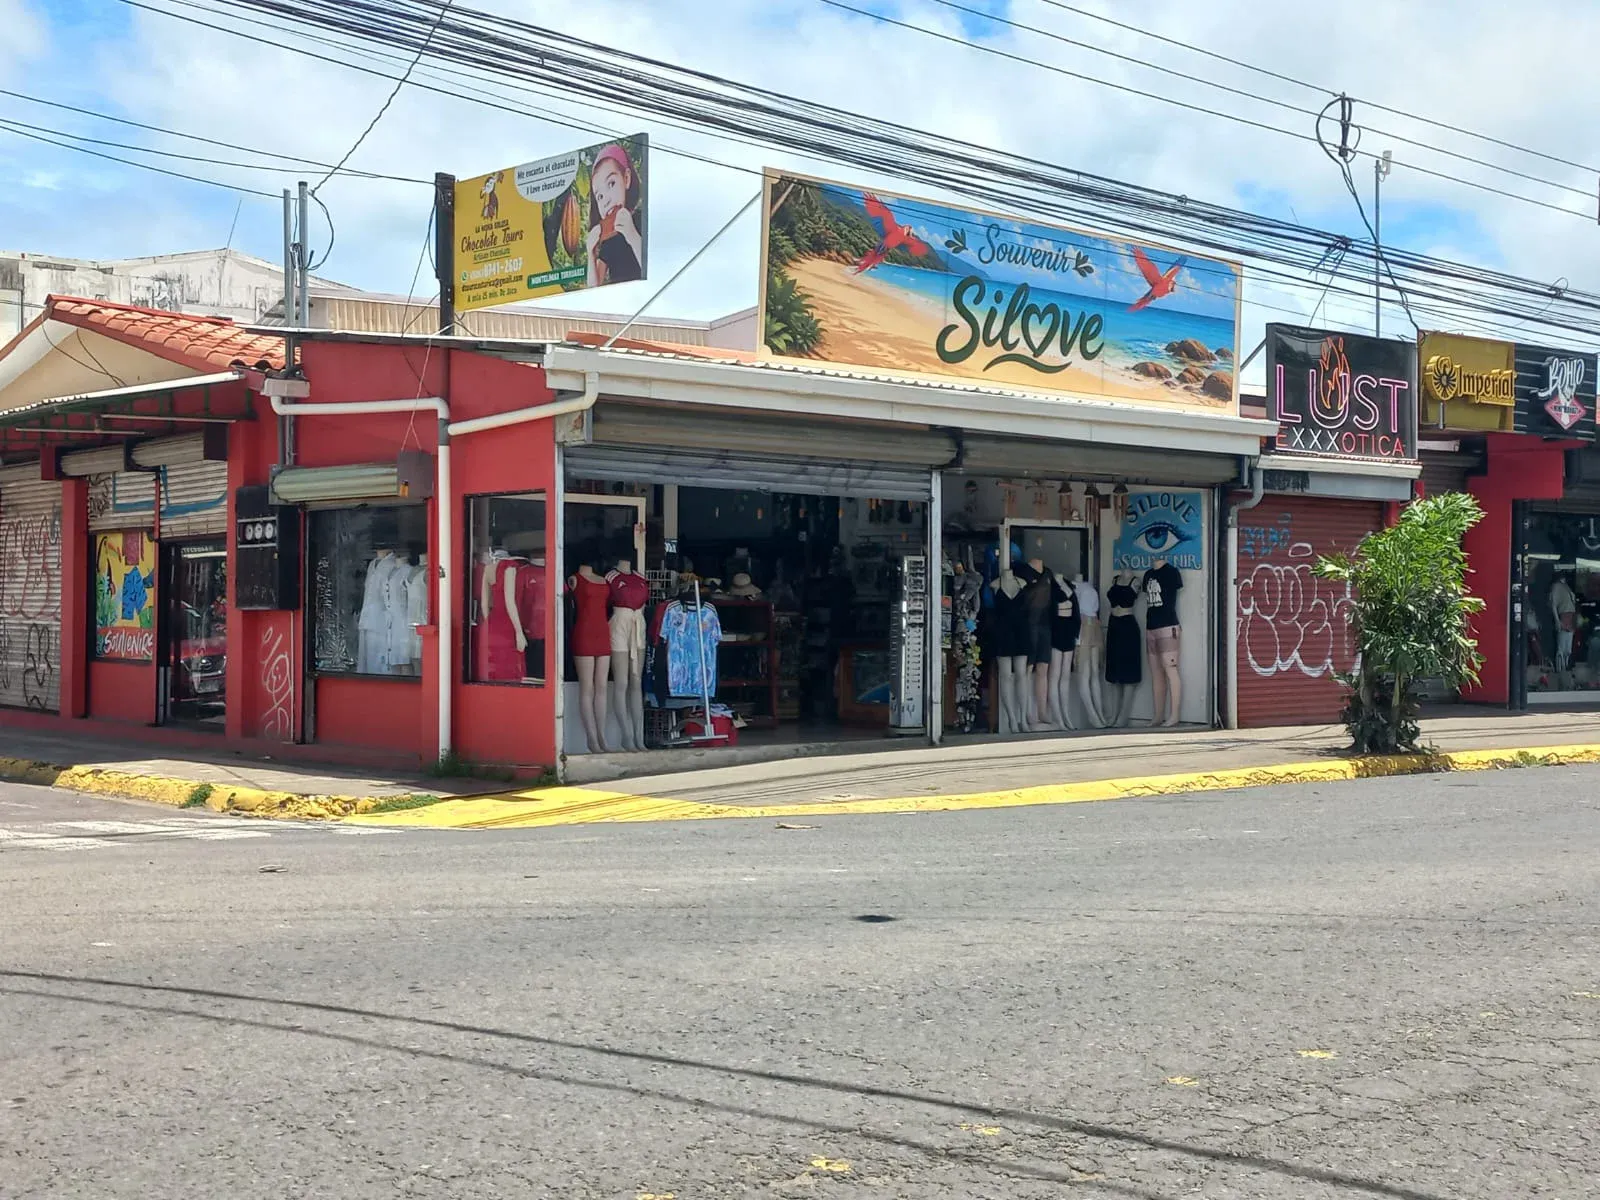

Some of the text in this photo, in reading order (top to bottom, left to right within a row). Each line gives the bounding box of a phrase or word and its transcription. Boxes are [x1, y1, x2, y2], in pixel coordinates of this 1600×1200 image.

[525, 166, 544, 178] encanta
[545, 163, 551, 173] el
[551, 158, 576, 171] chocolate
[541, 179, 566, 191] chocolate
[461, 227, 524, 253] Chocolate Tours
[978, 223, 1076, 273] Souvenir
[936, 275, 1105, 364] Silove
[1276, 364, 1409, 433] LUST
[1457, 363, 1516, 404] Imperial
[1275, 425, 1406, 457] EXXXOTICA
[1125, 492, 1197, 527] SILOVE
